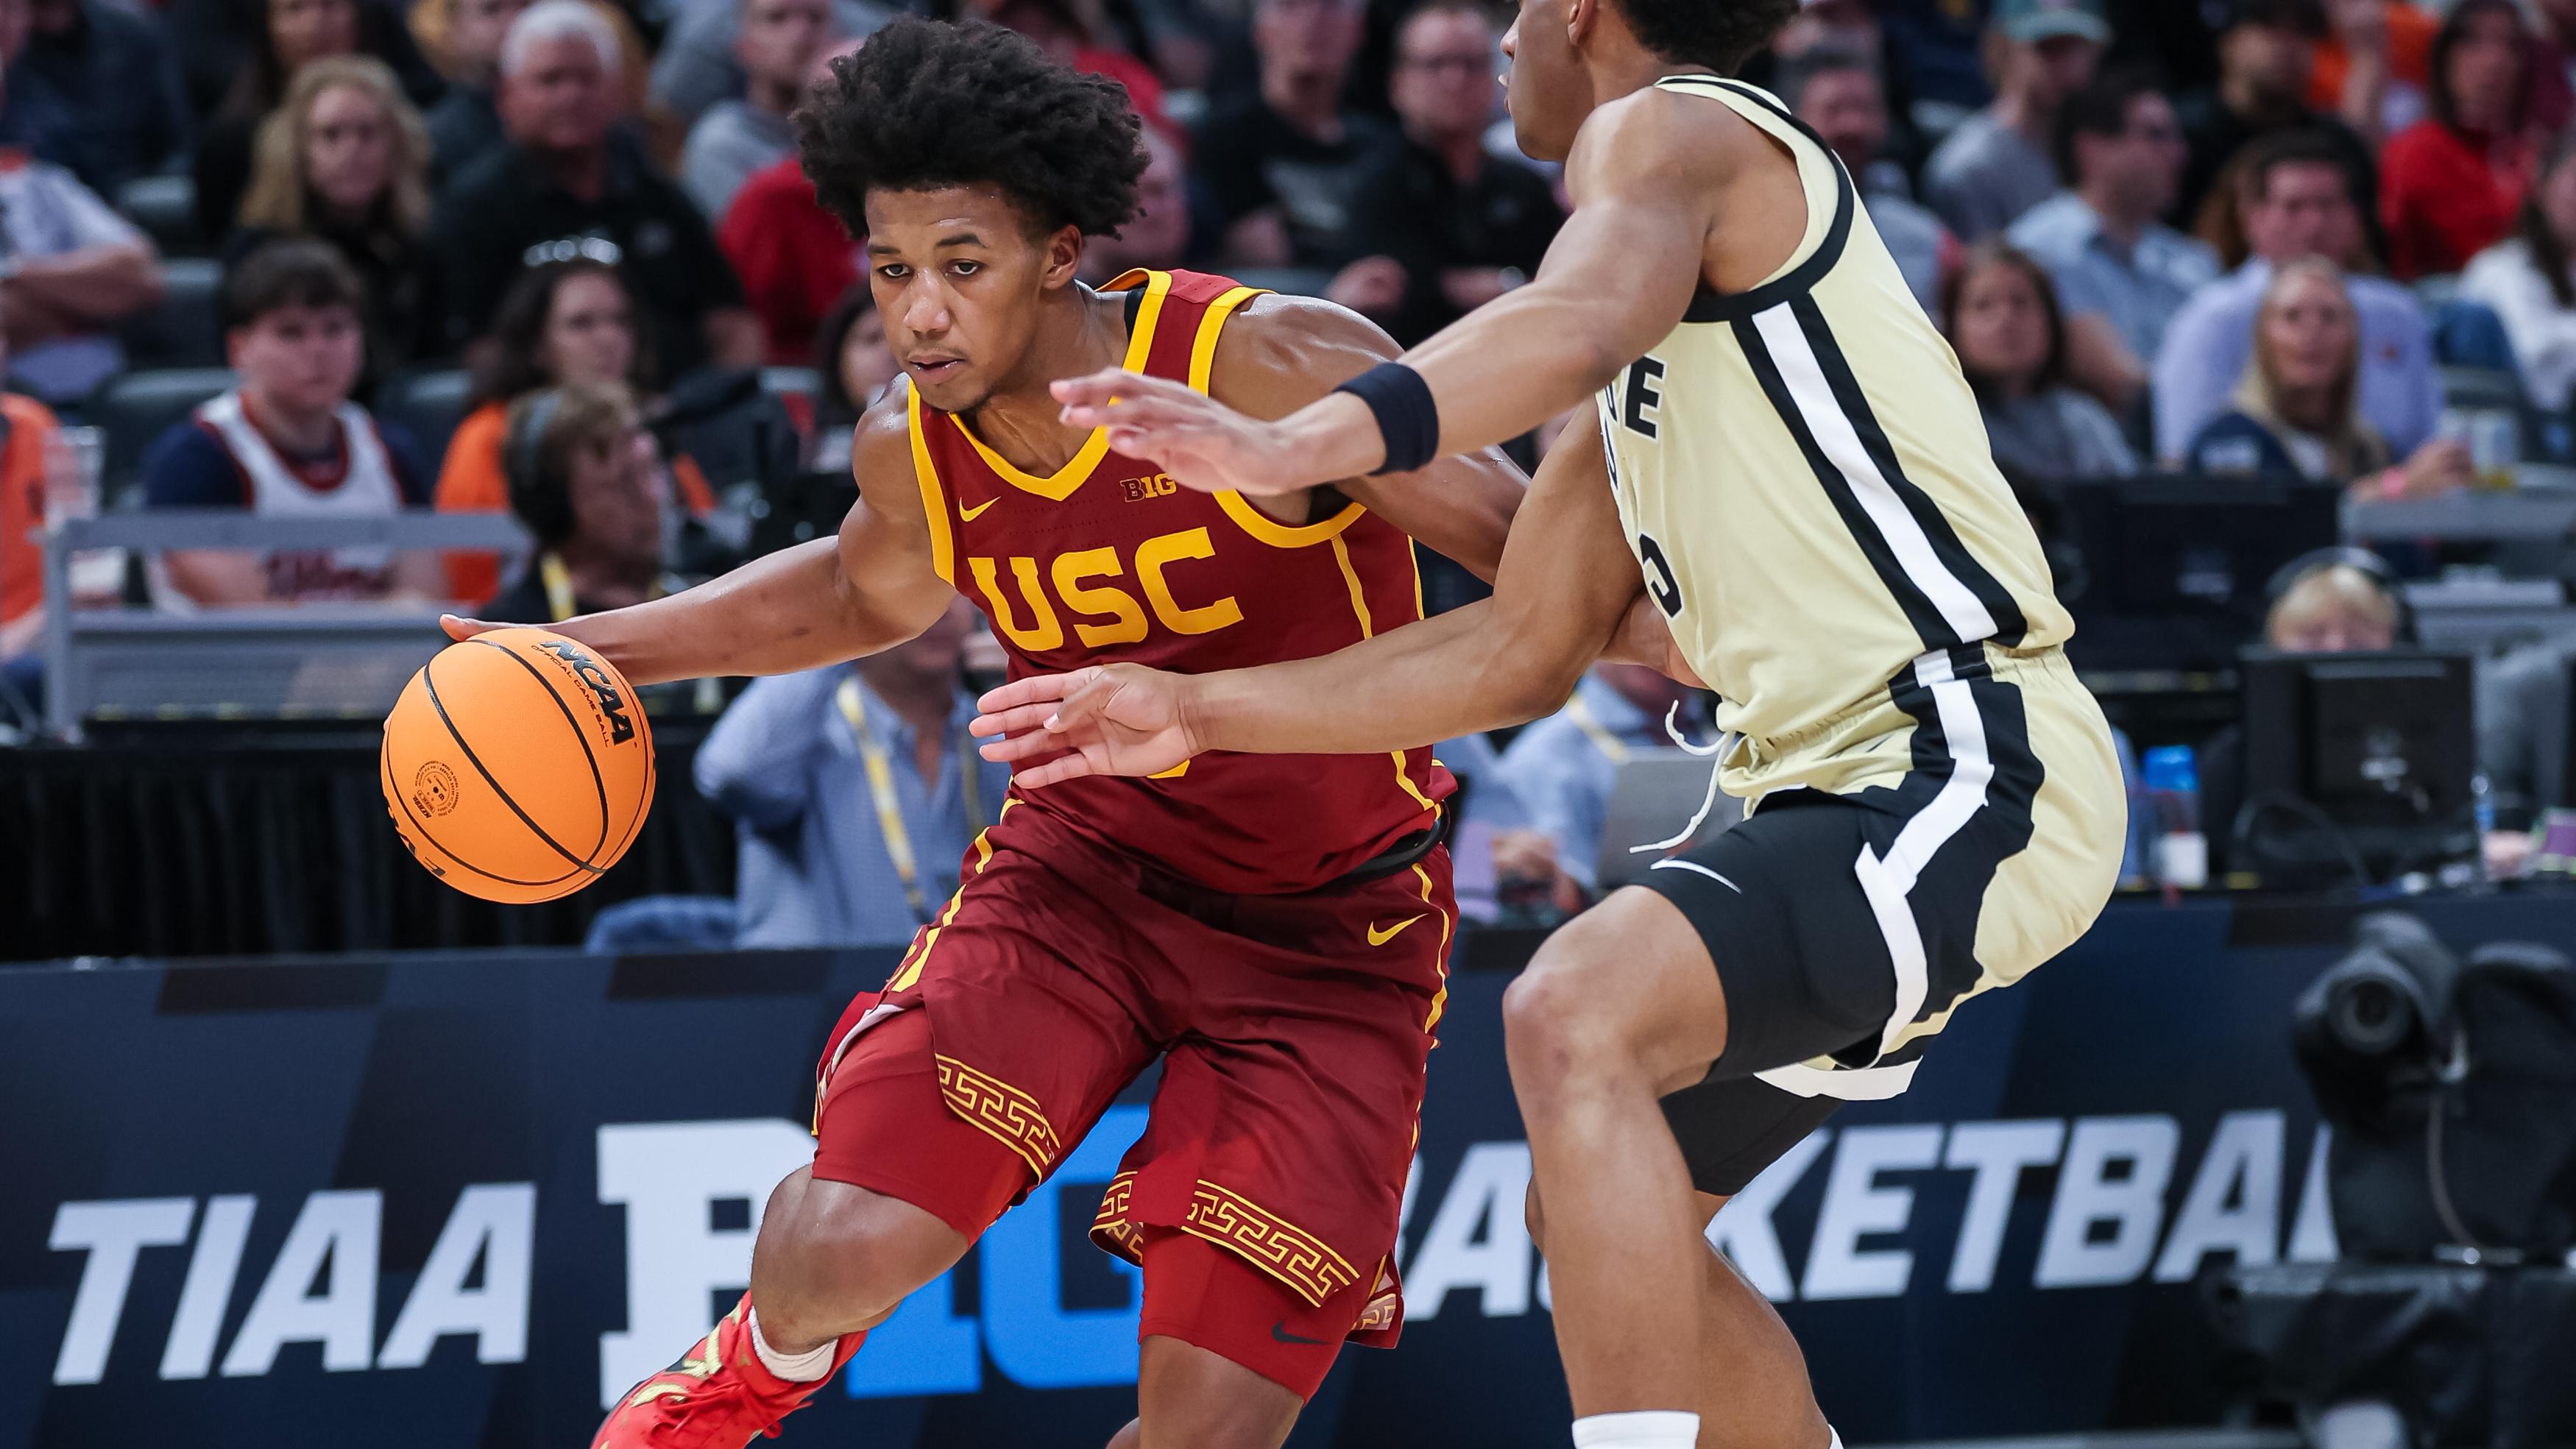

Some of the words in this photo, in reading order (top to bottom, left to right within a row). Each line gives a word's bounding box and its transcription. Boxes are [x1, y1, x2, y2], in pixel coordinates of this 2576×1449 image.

[967, 526, 1245, 651] USC
[531, 645, 573, 679] OFFICIAL
[573, 679, 598, 712] GAME
[595, 714, 610, 748] BALL
[539, 640, 636, 746] NCAA
[48, 1181, 537, 1386] TIAA
